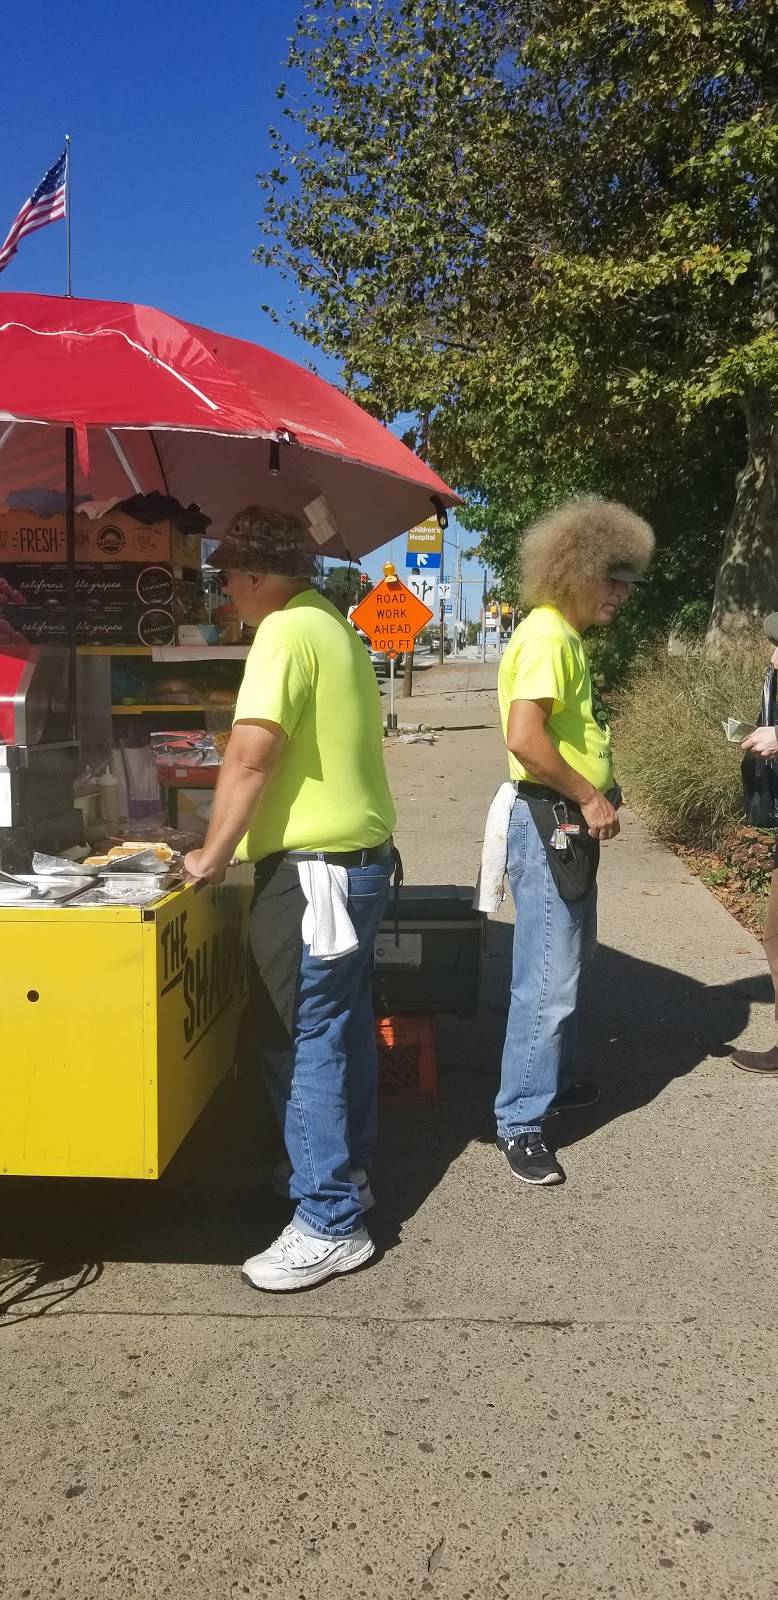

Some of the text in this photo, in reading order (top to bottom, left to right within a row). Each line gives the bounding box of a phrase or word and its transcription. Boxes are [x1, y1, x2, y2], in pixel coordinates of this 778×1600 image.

[20, 528, 58, 552] FRESH
[409, 534, 436, 542] Hospital
[20, 579, 64, 595] california
[376, 593, 407, 605] ROAD
[376, 609, 407, 619] WORK
[374, 624, 411, 635] AHEAD
[374, 639, 411, 650] 100 FT
[160, 911, 187, 980] THE
